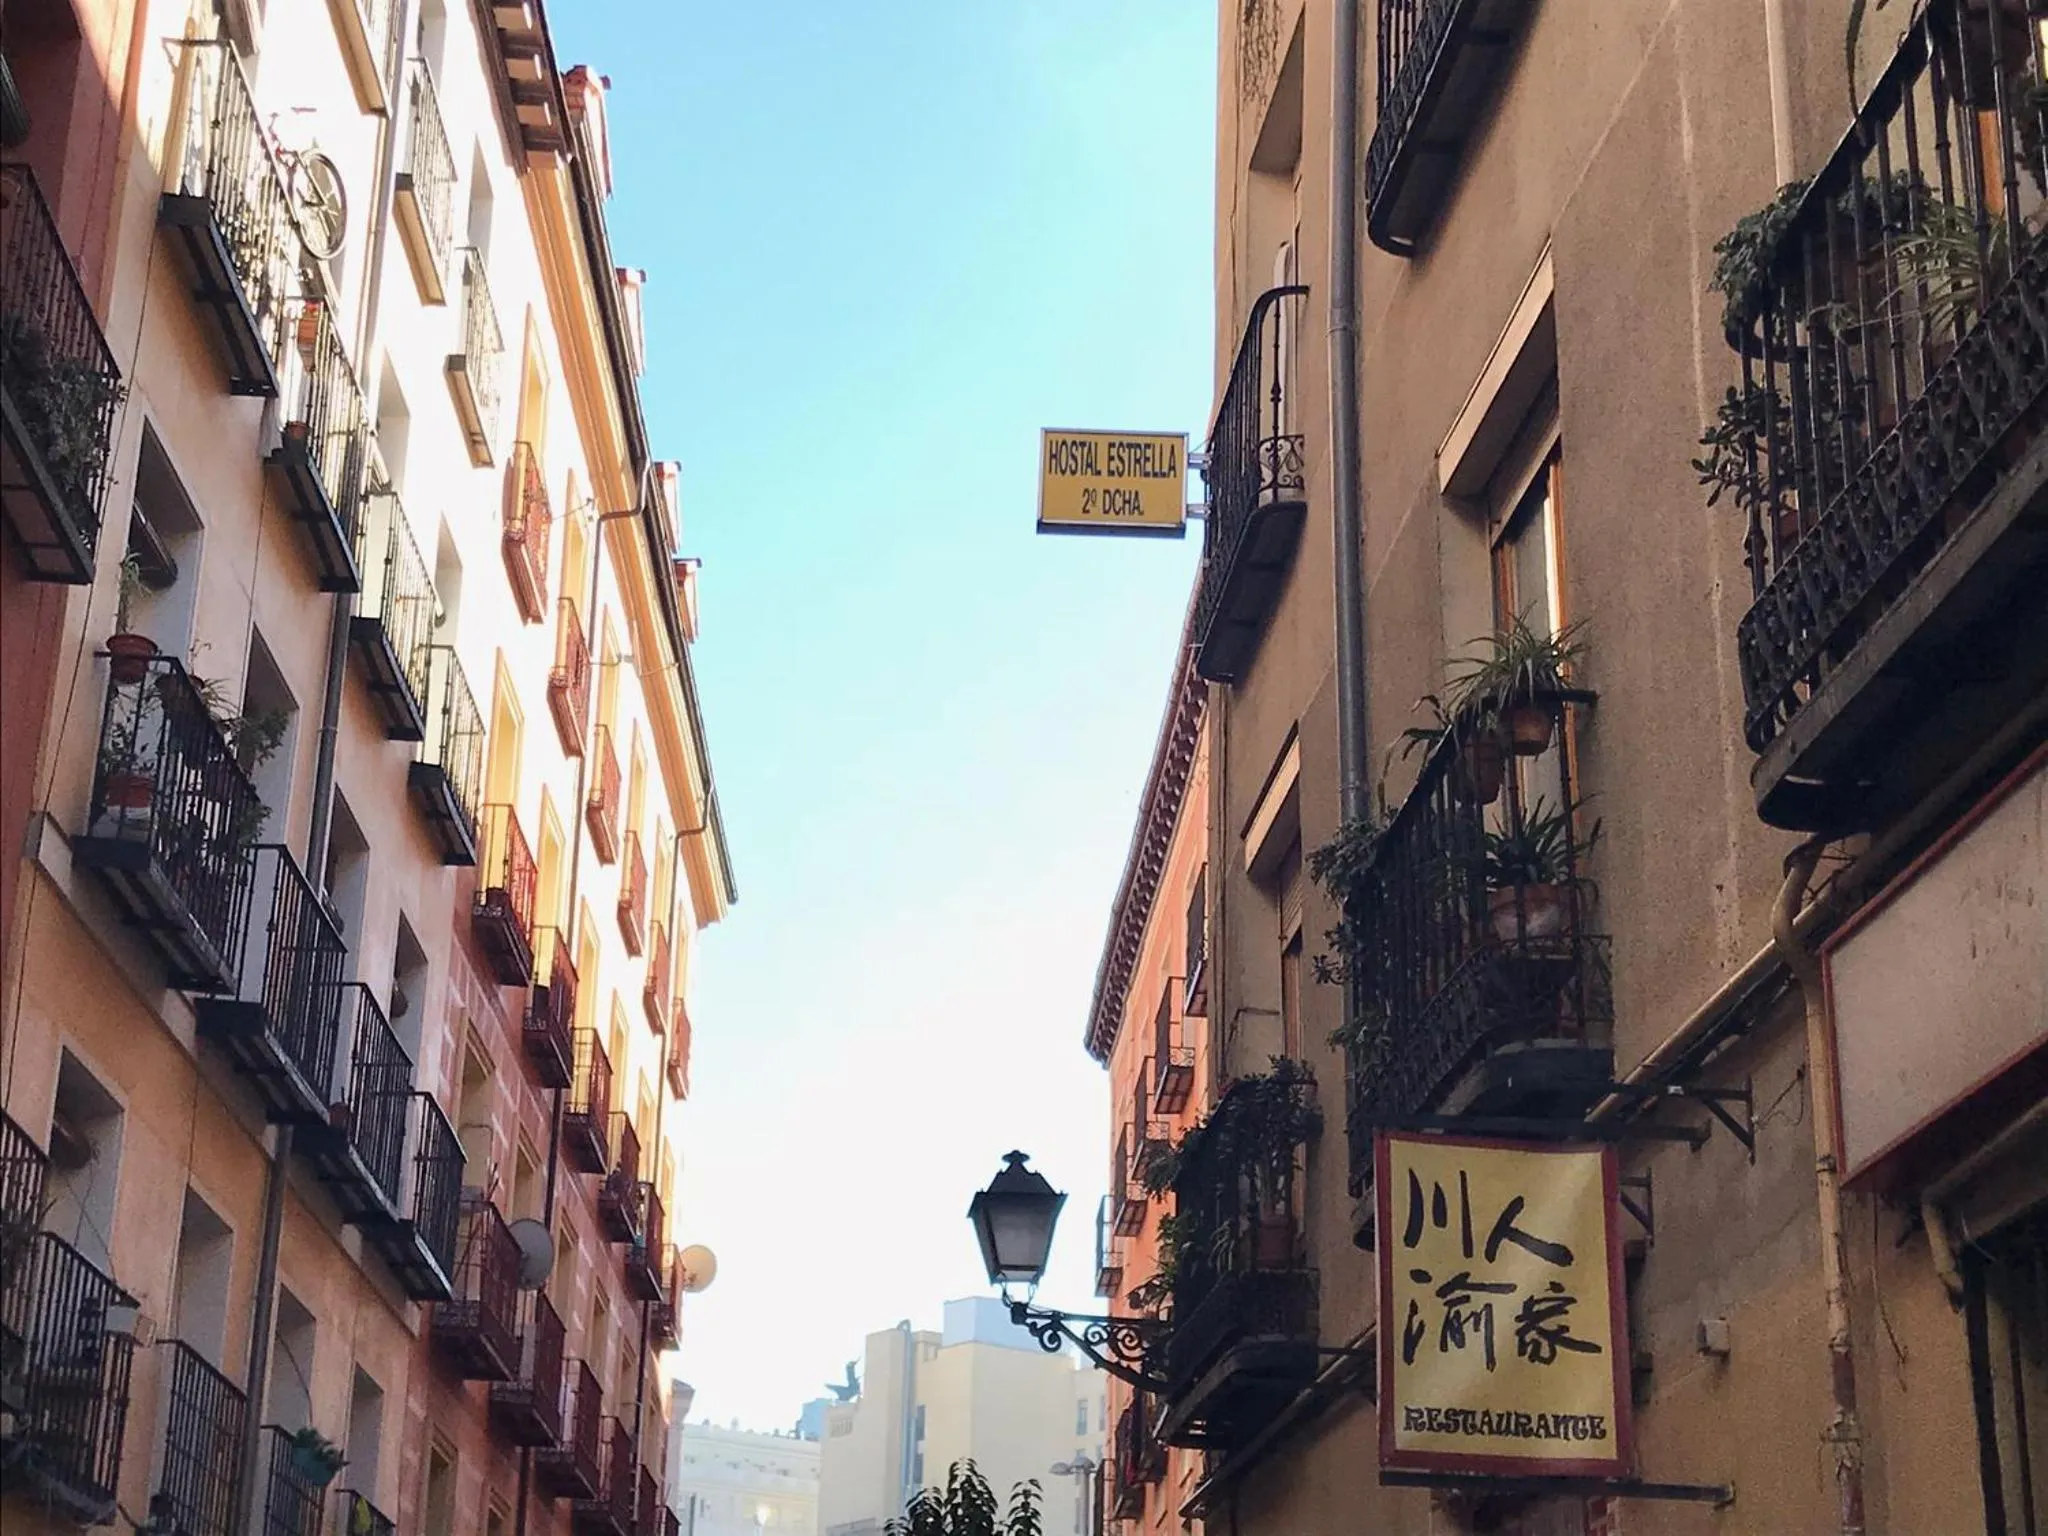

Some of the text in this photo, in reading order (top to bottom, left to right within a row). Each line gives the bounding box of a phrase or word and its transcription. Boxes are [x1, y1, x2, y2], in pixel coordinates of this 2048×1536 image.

[1049, 440, 1177, 478] HOSTAL ESTRELLA
[1404, 1405, 1607, 1441] RESTAURANTE
